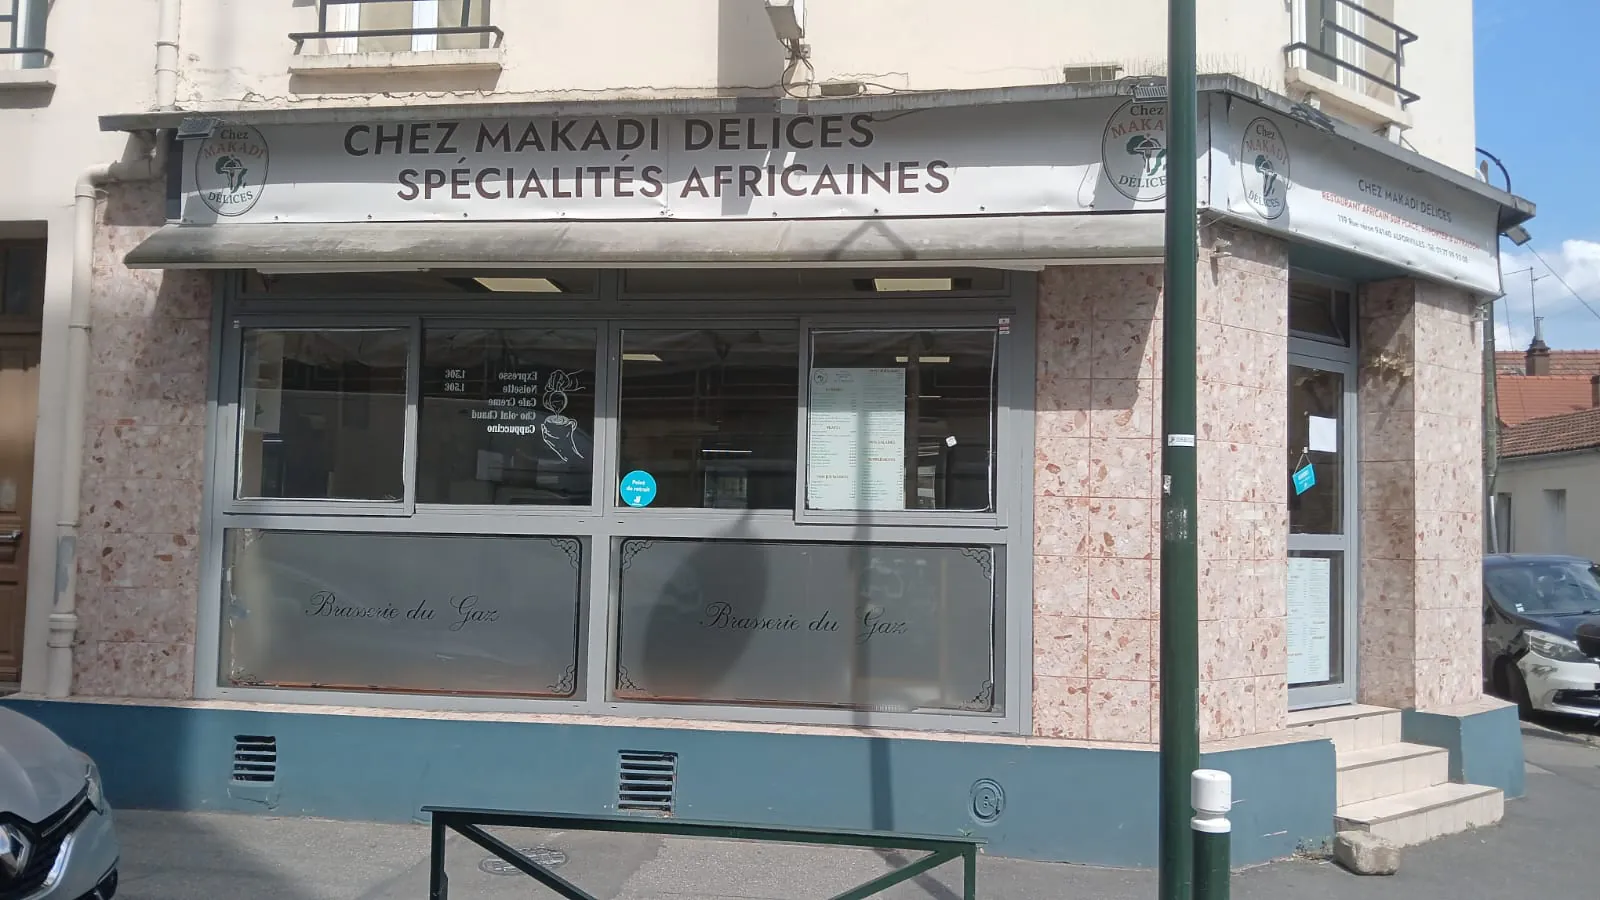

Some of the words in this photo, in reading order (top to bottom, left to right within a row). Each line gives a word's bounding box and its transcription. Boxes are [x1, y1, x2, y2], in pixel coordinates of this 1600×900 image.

[1130, 105, 1164, 116] Chez
[220, 128, 249, 141] Chez
[344, 121, 458, 156] CHEZ
[475, 118, 659, 154] MAKADI
[684, 114, 874, 151] DELICES
[1111, 118, 1165, 139] MAKA
[1256, 124, 1276, 139] Chez
[204, 141, 264, 160] MAKADI
[397, 154, 663, 200] SPÉCIALITÉS
[680, 159, 950, 199] AFRICAINES
[1118, 175, 1167, 189] DÉLICE
[1321, 191, 1361, 212] RESTAURANT
[1358, 179, 1382, 198] CHEZ
[1385, 190, 1419, 211] MAKADI
[1421, 201, 1453, 223] DELICES
[305, 590, 400, 620] Brasserie
[406, 600, 436, 620] du
[449, 594, 500, 632] Gaz
[698, 601, 800, 631] Brasserie
[808, 610, 840, 632] du
[854, 606, 909, 645] Gaz
